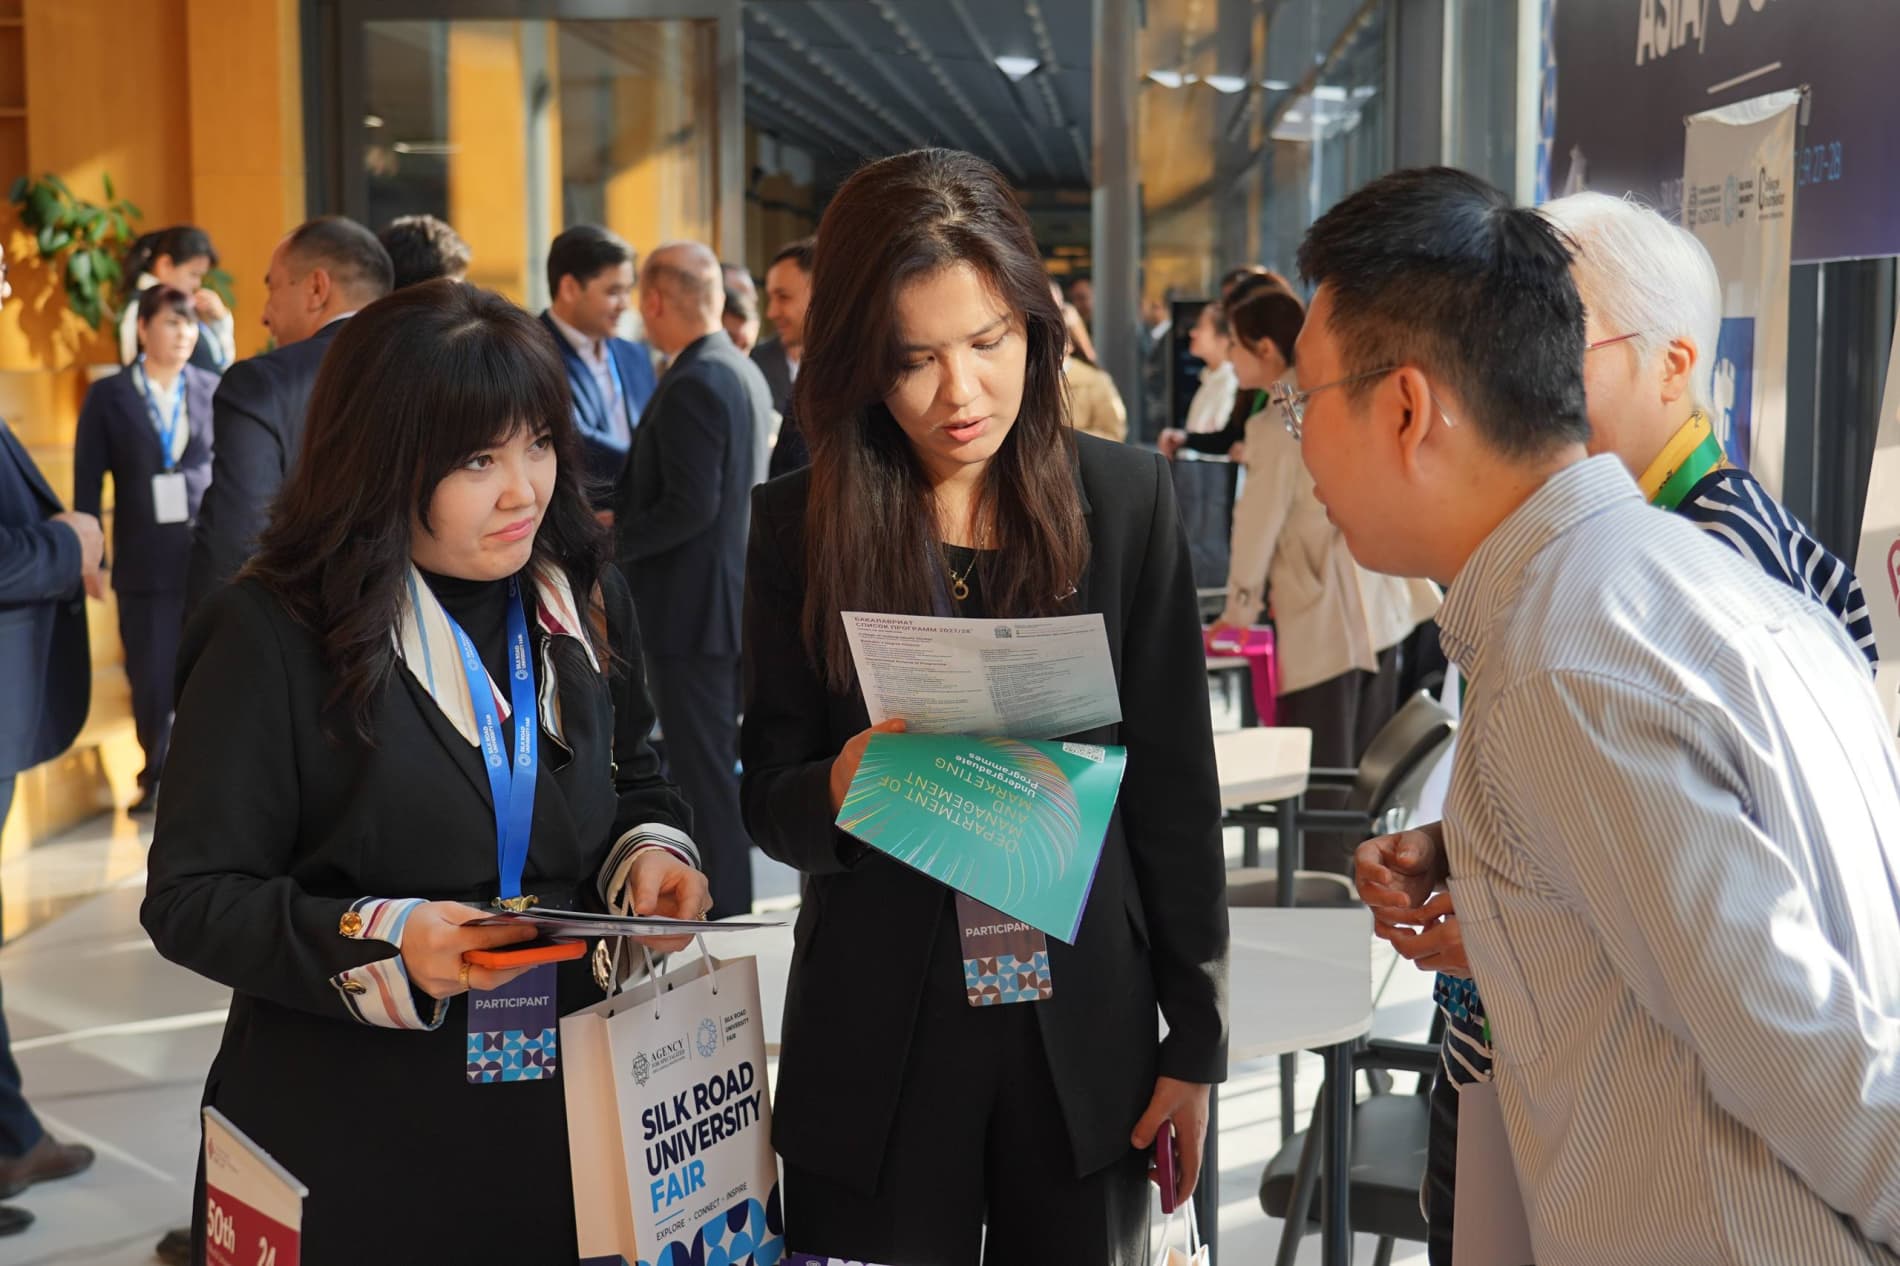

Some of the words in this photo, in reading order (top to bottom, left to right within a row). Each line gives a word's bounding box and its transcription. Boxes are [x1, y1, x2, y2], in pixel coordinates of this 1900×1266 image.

[880, 775, 901, 792] OF
[935, 757, 1033, 811] MARKETING
[955, 755, 1036, 798] Undergraduate
[969, 752, 1039, 791] Programmes
[904, 771, 1024, 839] MANAGEMENT
[904, 789, 1019, 853] DEPARTMENT
[992, 800, 1028, 824] AND
[965, 922, 1034, 937] PARTICIPAN
[475, 996, 549, 1009] PARTICIPANT
[650, 1038, 684, 1061] AGENCY
[641, 1090, 692, 1141] SILK
[692, 1061, 754, 1115] ROAD
[645, 1089, 761, 1176] UNIVERSITY
[650, 1159, 706, 1214] FAIR
[656, 1218, 686, 1241] EXPLORE
[693, 1198, 721, 1220] CONNECT
[726, 1182, 748, 1201] INSPIRE
[207, 1197, 236, 1254] 50th
